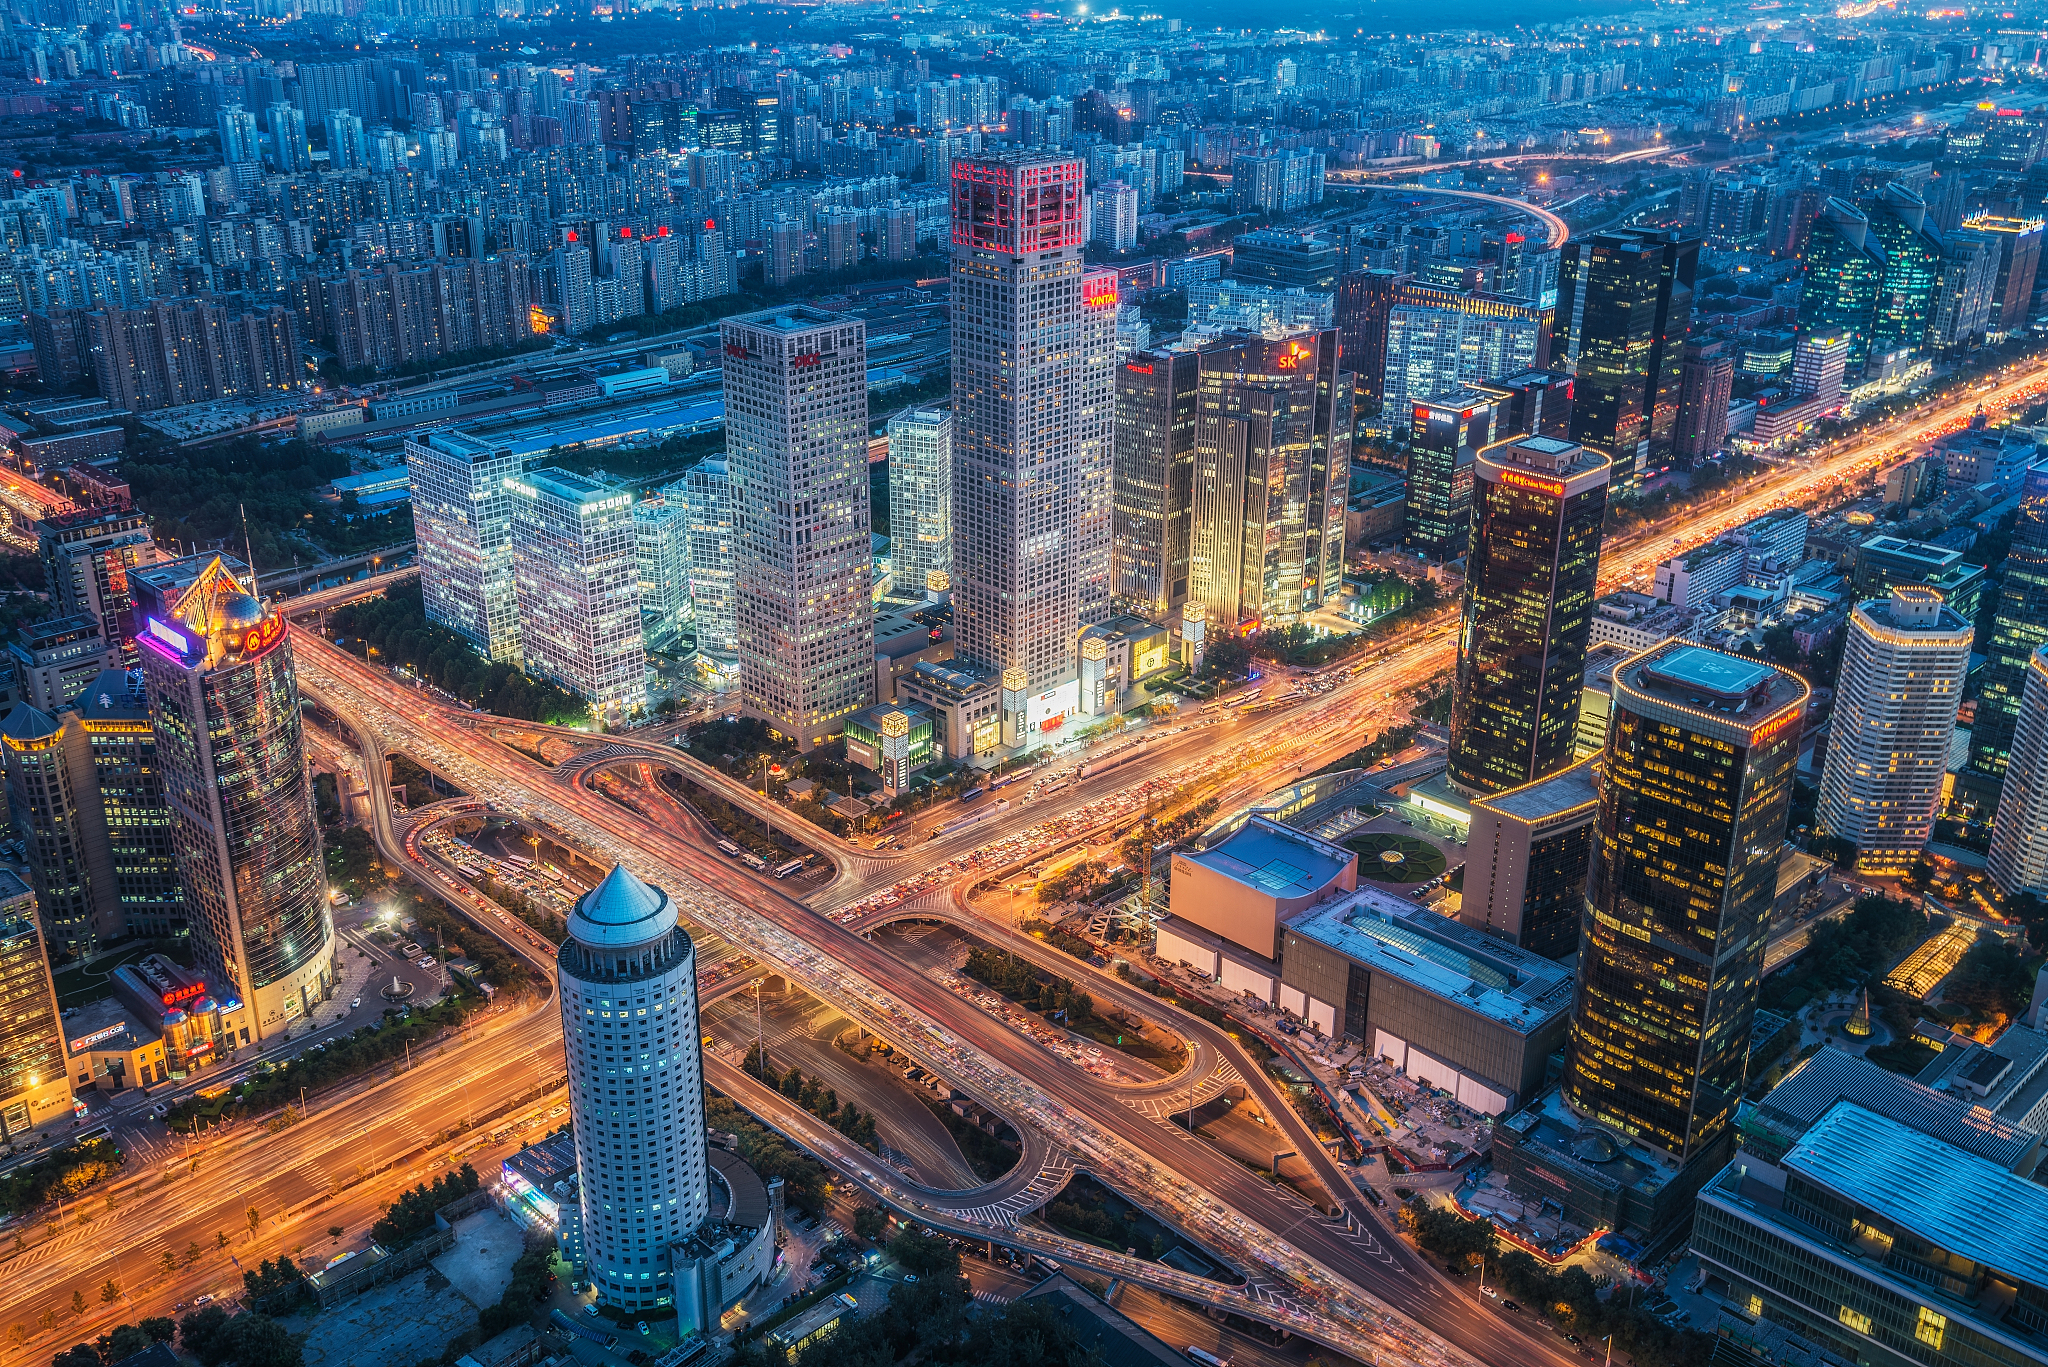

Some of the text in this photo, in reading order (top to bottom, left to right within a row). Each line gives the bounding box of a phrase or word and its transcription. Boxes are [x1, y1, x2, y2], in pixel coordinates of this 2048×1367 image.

[1090, 293, 1117, 307] YINTAI
[727, 343, 748, 360] PICC
[795, 352, 820, 369] PICC
[1278, 355, 1297, 369] SK
[1525, 480, 1538, 488] China
[1539, 481, 1554, 491] World
[75, 496, 132, 520] 中航工业
[110, 1024, 125, 1035] CGB
